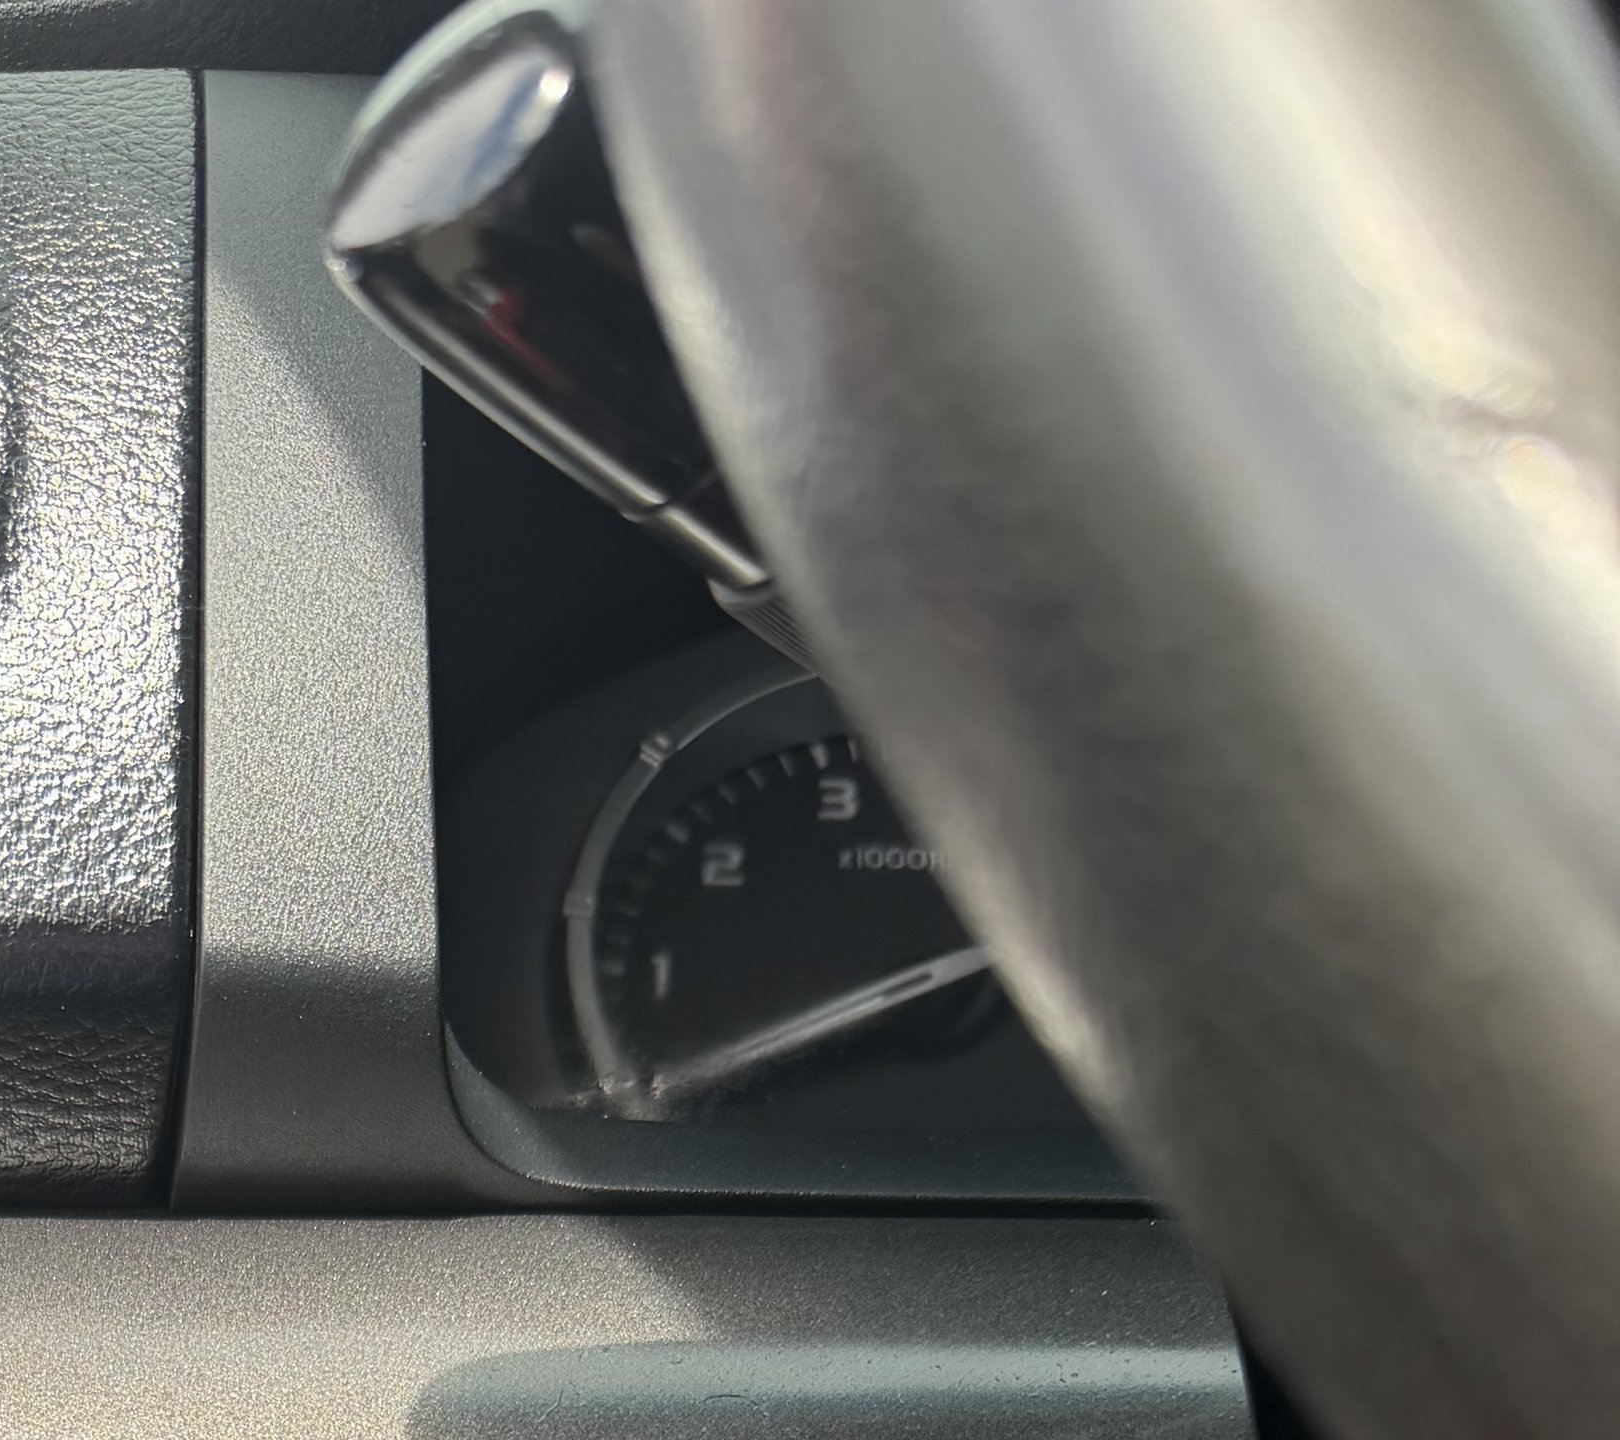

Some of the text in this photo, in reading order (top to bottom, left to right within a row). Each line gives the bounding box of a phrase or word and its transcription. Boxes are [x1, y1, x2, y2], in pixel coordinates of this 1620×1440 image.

[817, 777, 859, 822] 3
[701, 845, 745, 887] 2
[652, 953, 672, 998] 1
